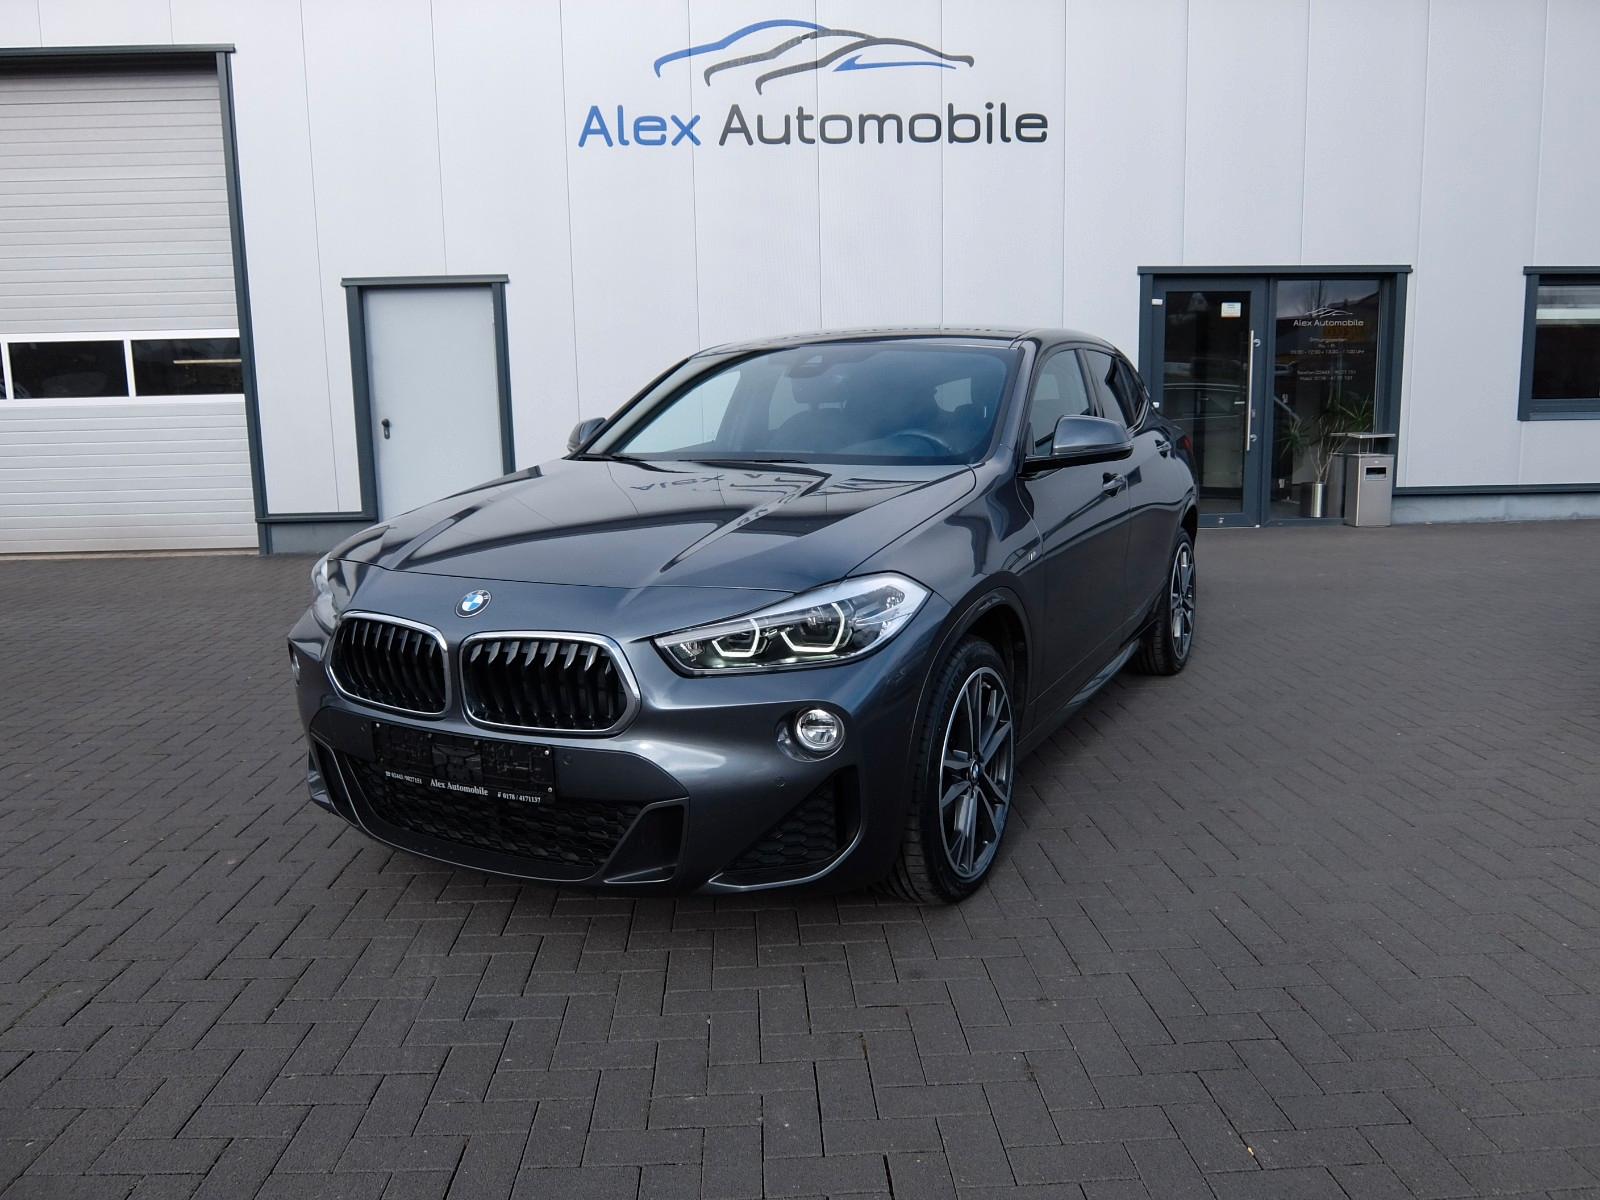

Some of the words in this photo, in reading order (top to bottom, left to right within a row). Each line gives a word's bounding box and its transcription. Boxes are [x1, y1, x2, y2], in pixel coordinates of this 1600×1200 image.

[578, 104, 702, 147] Alex
[718, 102, 1049, 147] Automobile
[1293, 319, 1312, 327] Alex
[1313, 319, 1365, 327] Automobile
[430, 778, 446, 789] Alex
[447, 781, 489, 796] Automobile
